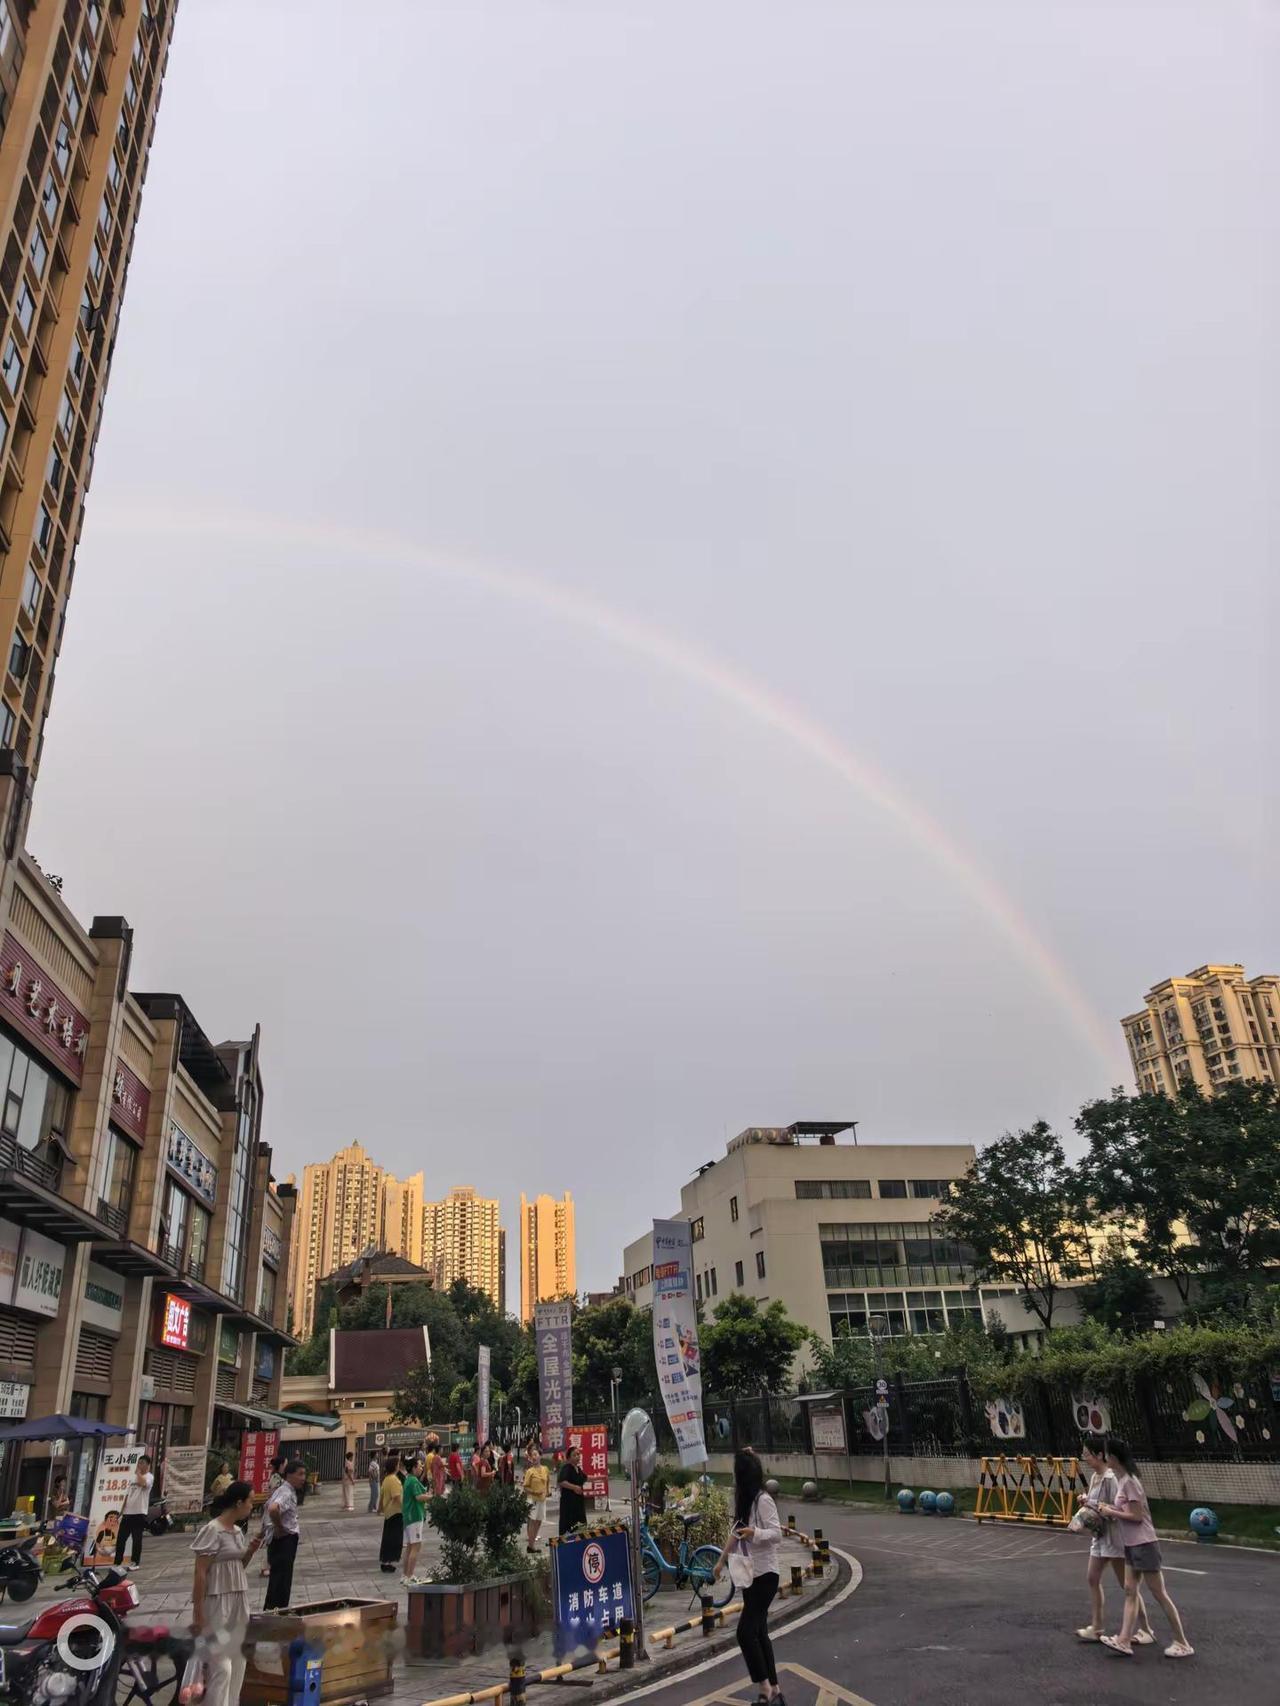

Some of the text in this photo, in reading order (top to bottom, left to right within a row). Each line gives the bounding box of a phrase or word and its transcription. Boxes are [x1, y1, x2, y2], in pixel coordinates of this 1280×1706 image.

[537, 1315, 569, 1328] FTTR
[541, 1333, 563, 1449] 全屋光宽带
[588, 1551, 600, 1574] 停
[569, 1582, 623, 1611] 消防车道
